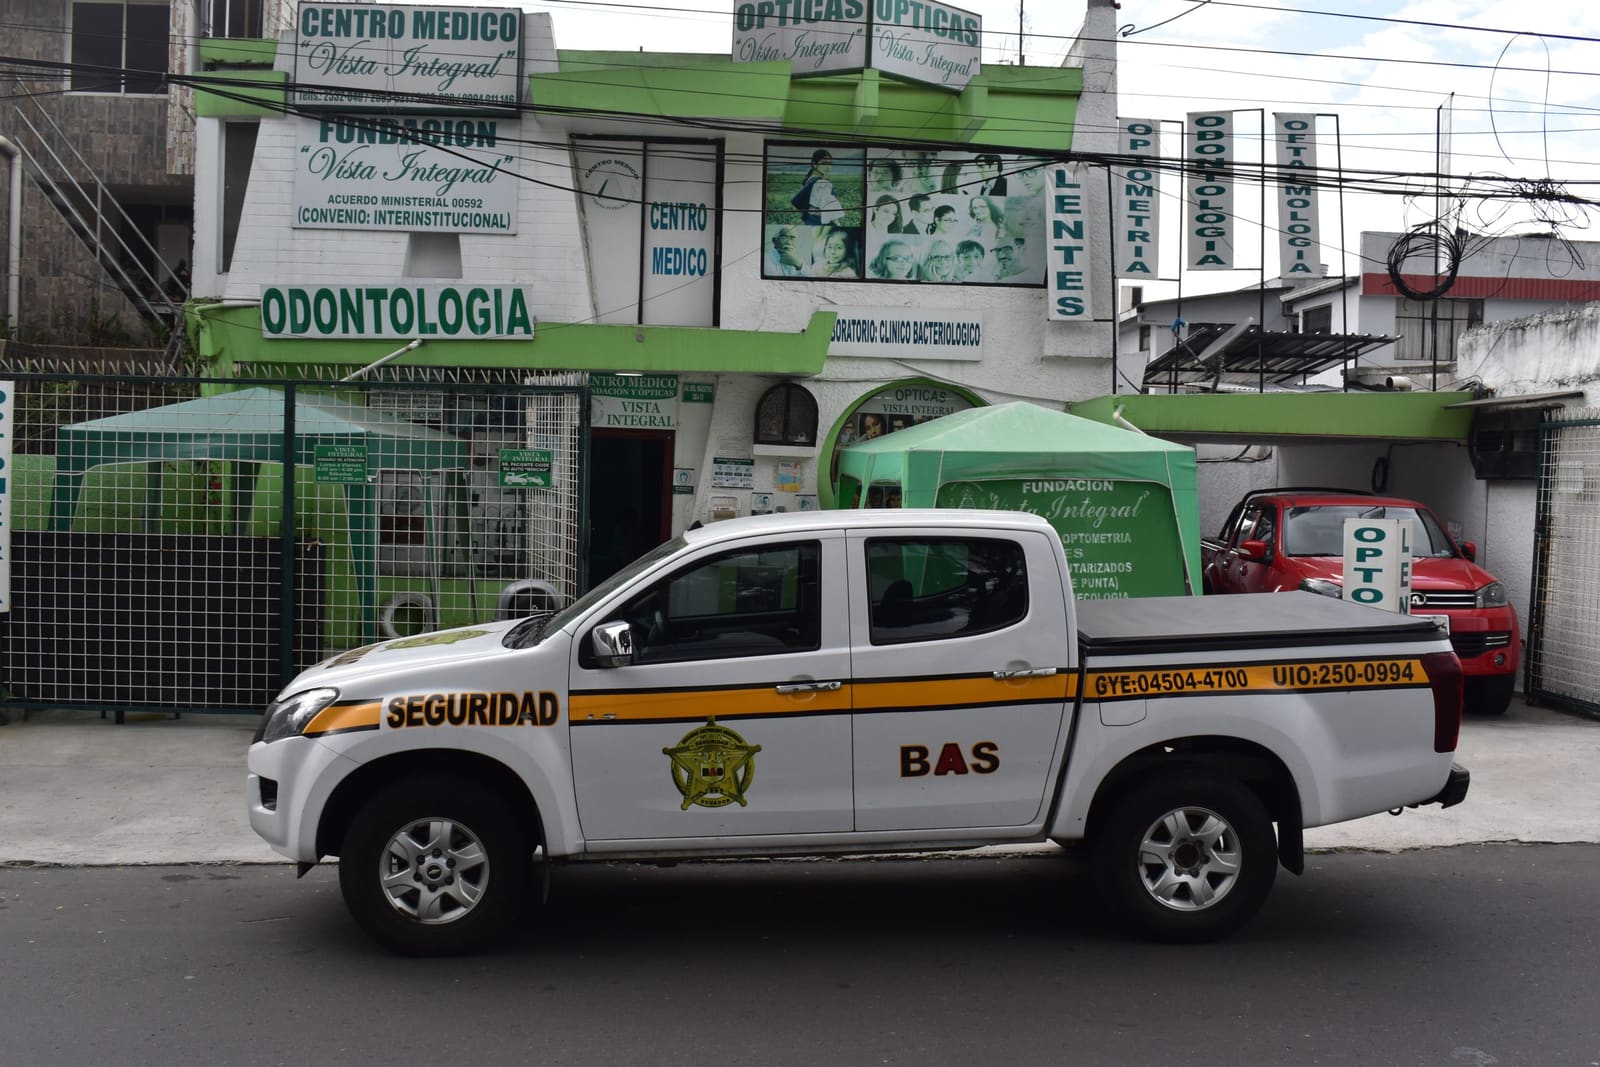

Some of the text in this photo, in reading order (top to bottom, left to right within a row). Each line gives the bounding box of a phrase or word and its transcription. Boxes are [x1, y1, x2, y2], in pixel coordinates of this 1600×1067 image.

[302, 7, 517, 42] CENTRO MEDICO
[736, 0, 865, 31] OPTICAS
[876, 0, 979, 47] OPTICAS
[319, 116, 497, 148] FUNDACION
[584, 159, 640, 180] CENTRO MEDICO
[327, 194, 484, 209] ACUERDO MINISTERIAL 00592
[650, 201, 708, 231] CENTRO
[298, 206, 511, 231] (CONVENIO: INTERINSTITUCIONAL)
[1053, 169, 1085, 317] LENTES
[652, 246, 707, 276] MEDICO
[262, 287, 532, 336] ODONTOLOGIA
[879, 319, 911, 345] CLINICO
[913, 320, 981, 347] BACTERIOLOGICO
[591, 375, 677, 389] NTRO MEDICO
[895, 388, 948, 404] OPTICAS
[607, 414, 675, 427] INTEGRAL
[622, 401, 660, 414] VISTA
[883, 403, 910, 414] VISTA
[1022, 480, 1114, 494] FUNDACION
[1062, 532, 1132, 544] OPTOMETRIA
[1351, 527, 1387, 604] OPTO
[1081, 576, 1119, 590] PUNTA)
[1095, 662, 1414, 696] GYE:04504-4700 UIO:250-0994
[387, 691, 559, 728] SEGURIDAD
[900, 741, 1000, 778] BAS
